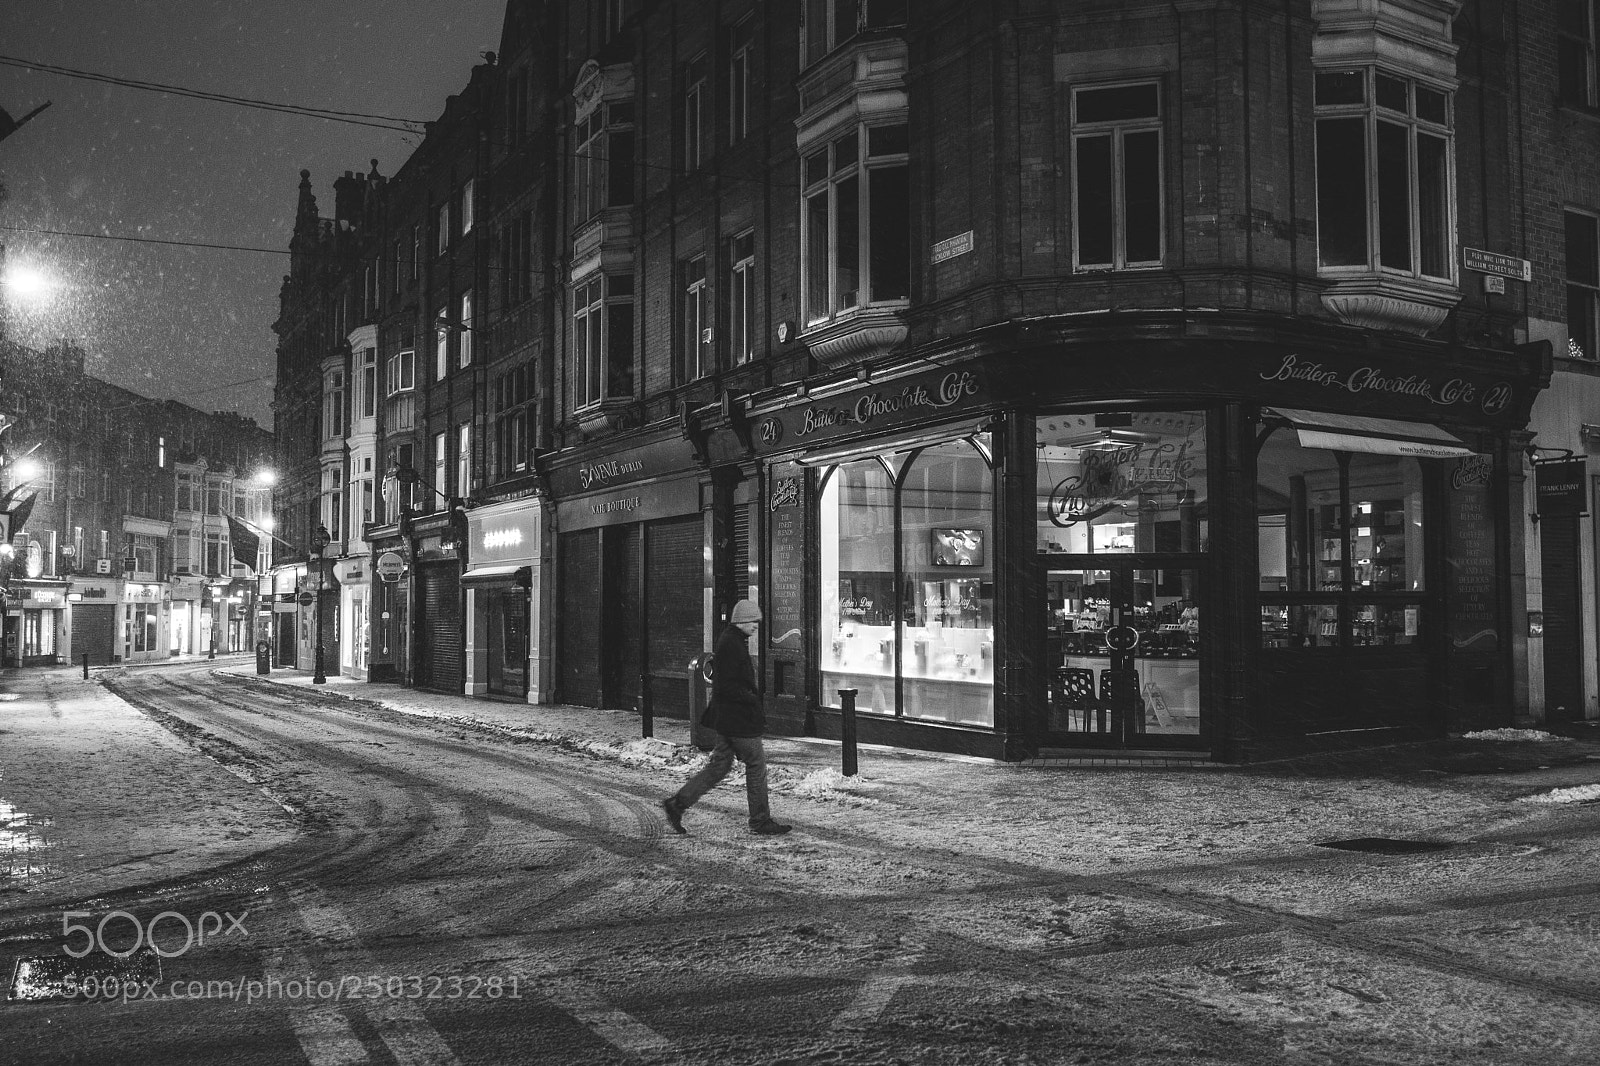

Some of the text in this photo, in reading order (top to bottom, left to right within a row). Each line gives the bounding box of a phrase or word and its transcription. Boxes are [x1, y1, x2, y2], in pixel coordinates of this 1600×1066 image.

[952, 243, 969, 255] STREET
[1466, 260, 1487, 269] WILLIAM
[1488, 264, 1507, 273] STREET
[1525, 266, 1530, 276] 2
[1260, 353, 1509, 408] Butlers Chocolate Café 24
[762, 422, 777, 441] 24
[854, 386, 929, 423] Chocolate
[939, 372, 980, 407] Café
[620, 460, 643, 474] DUBLIN
[1559, 483, 1579, 491] LENNY
[591, 496, 639, 514] NAIL BOUTIQUE
[859, 596, 873, 610] Day
[953, 594, 970, 609] Day
